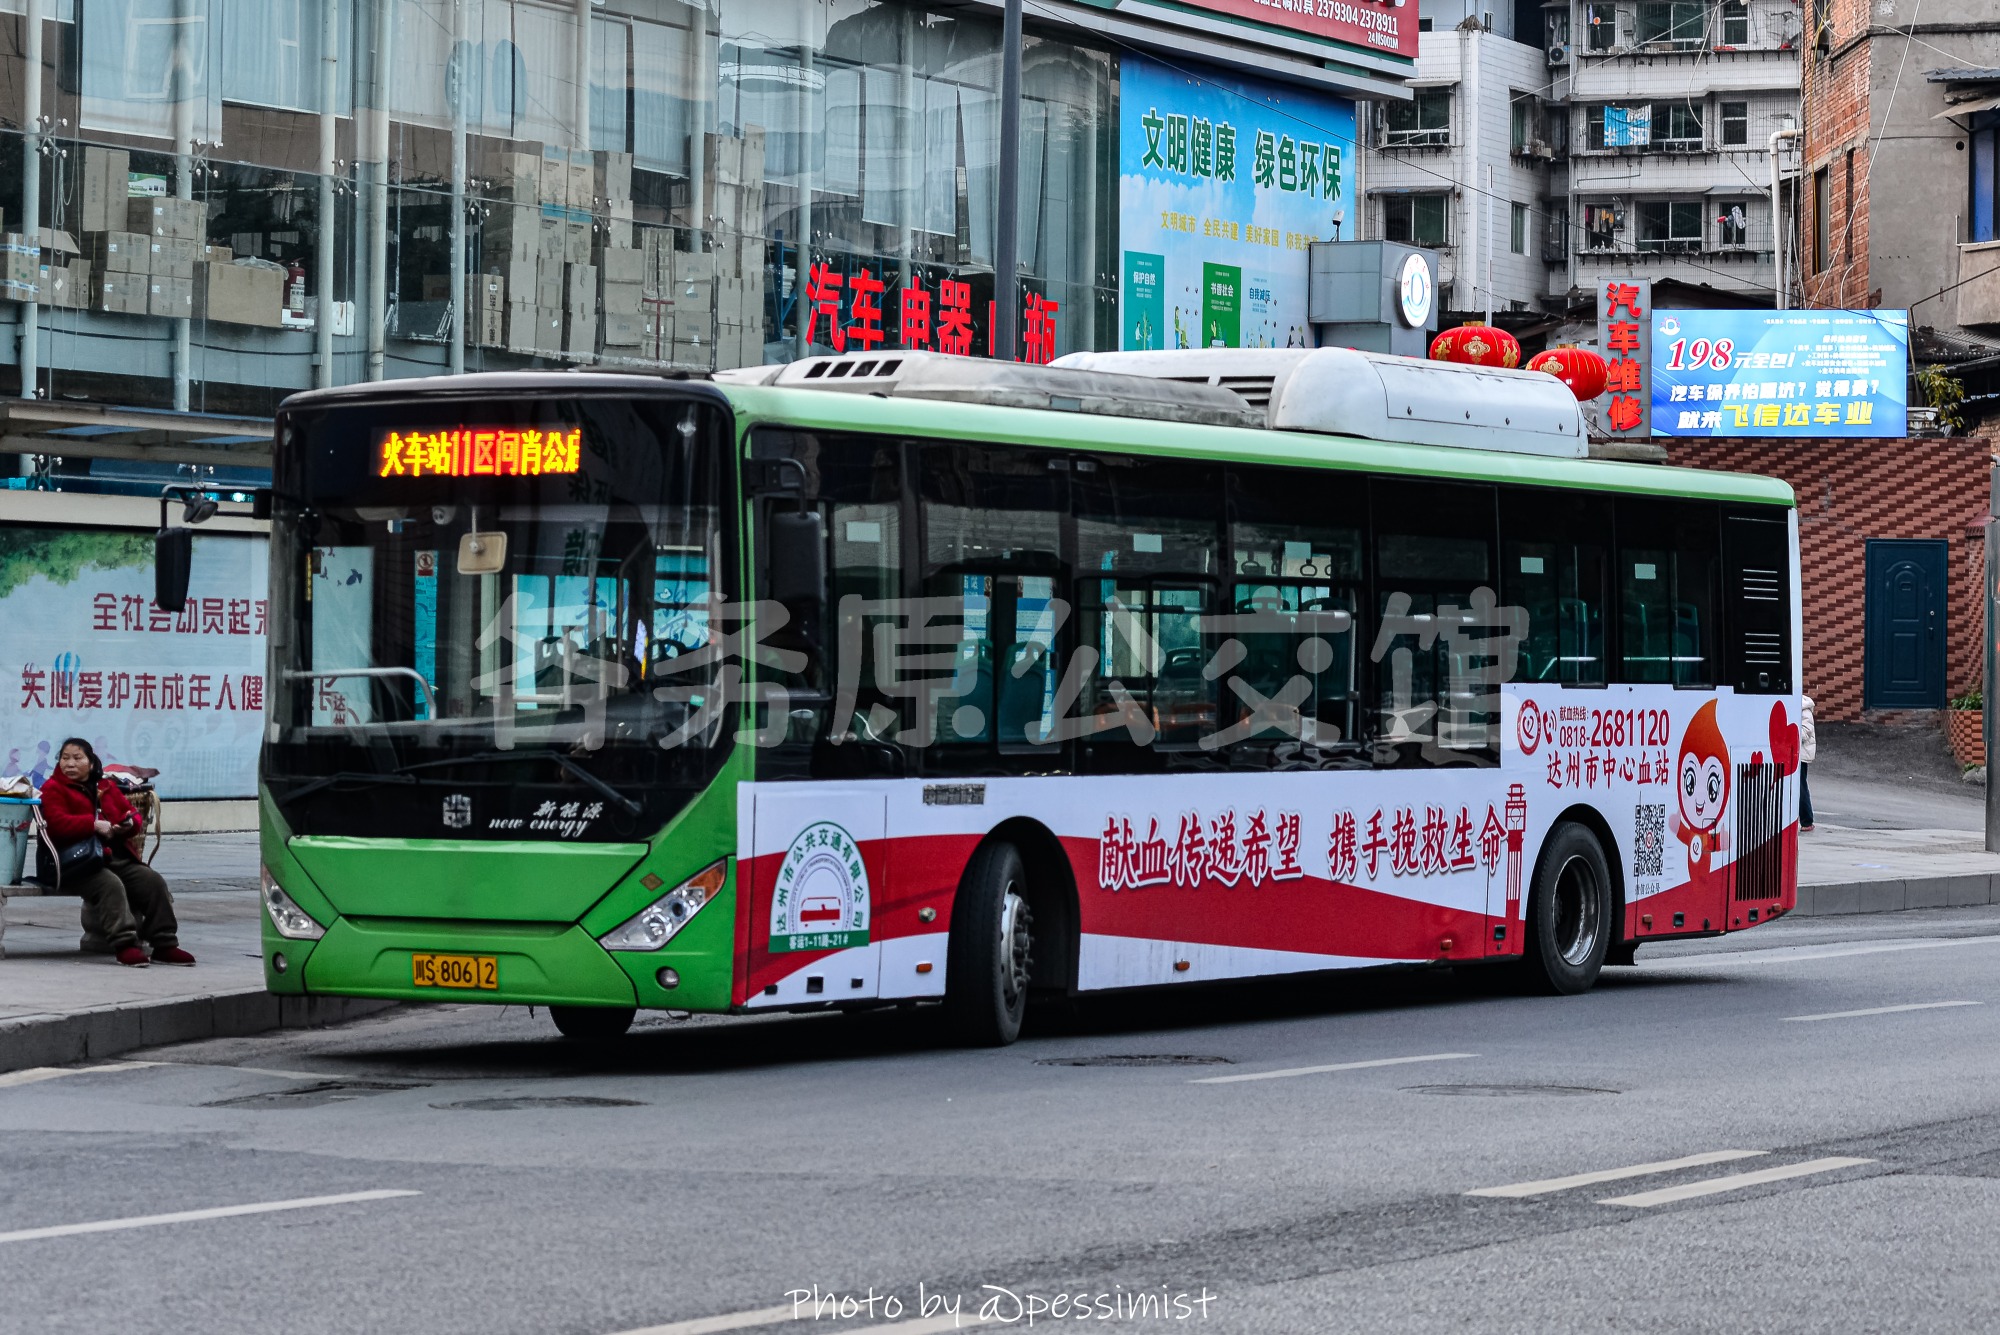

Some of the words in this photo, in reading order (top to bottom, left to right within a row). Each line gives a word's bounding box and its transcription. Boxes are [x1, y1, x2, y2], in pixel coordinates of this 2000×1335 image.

[1316, 0, 1359, 25] 2379304
[1360, 8, 1399, 36] 2378911
[1142, 107, 1236, 182] 文明健康
[1255, 128, 1342, 201] 绿色环保
[1161, 211, 1197, 233] 文明城市
[1203, 218, 1239, 241] 全民共建
[1245, 225, 1279, 247] 美好家园
[1133, 271, 1156, 286] 保护自然
[1249, 287, 1271, 302] 自我减压
[805, 262, 1059, 365] 汽车电器瓶
[1606, 281, 1643, 431] 汽车维修
[1677, 401, 1874, 430] 就来飞信达车业
[1547, 748, 1670, 790] 达州市中心血站
[489, 818, 525, 829] new
[530, 818, 590, 837] energy
[533, 800, 603, 819] 新能源
[1100, 807, 1303, 889] 献血传递希望
[1328, 802, 1508, 880] 携手挽救生命
[776, 829, 865, 933] 达州市公共交通有限公司
